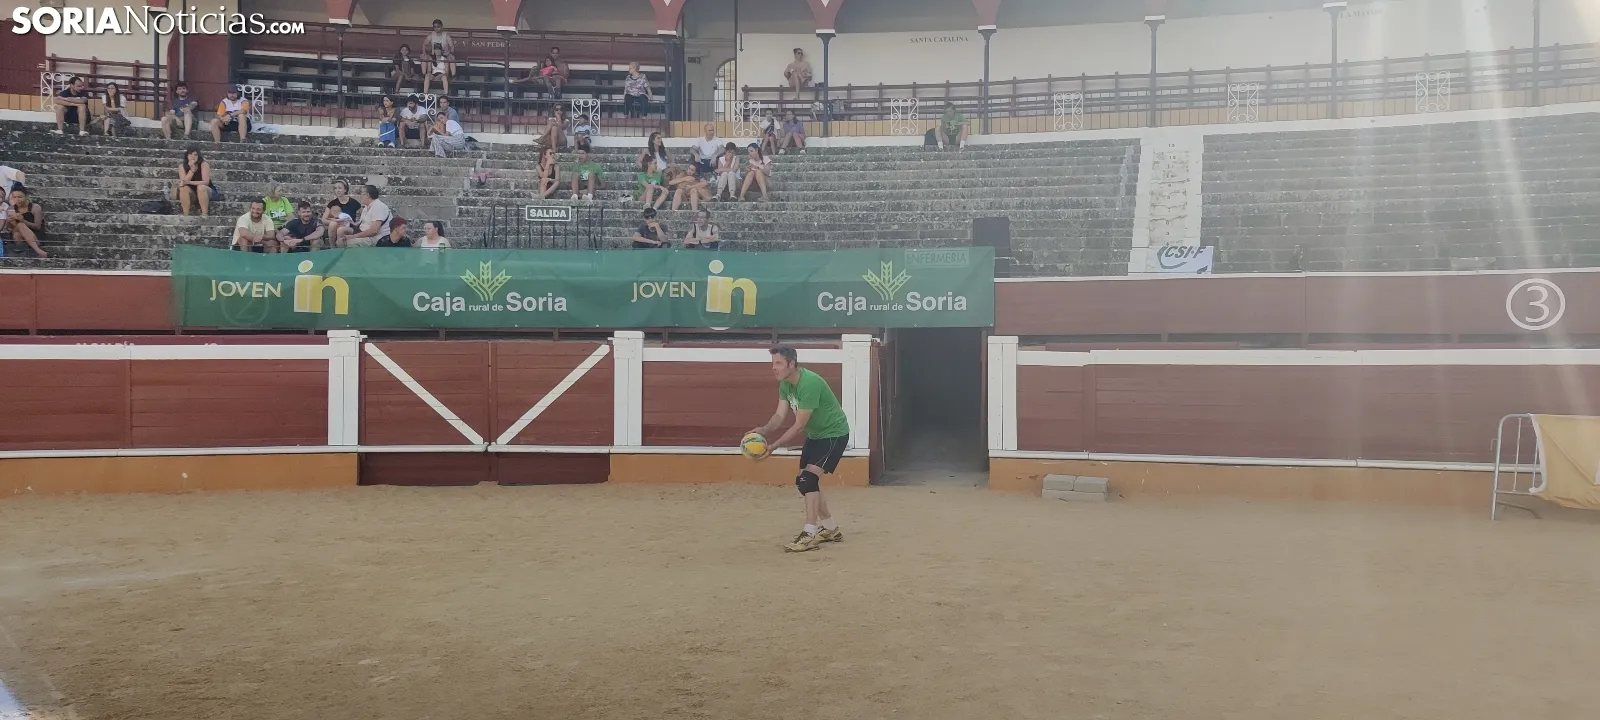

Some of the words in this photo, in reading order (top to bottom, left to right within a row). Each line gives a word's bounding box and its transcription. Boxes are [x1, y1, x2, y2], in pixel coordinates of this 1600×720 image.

[529, 208, 567, 218] SALIDA
[209, 279, 282, 301] JOVEN
[293, 259, 350, 315] in
[631, 281, 696, 303] JOVEN
[705, 259, 758, 316] in
[412, 291, 466, 317] Caja
[468, 303, 490, 312] rural
[491, 303, 504, 312] de
[506, 291, 568, 312] Soria
[817, 291, 868, 316] Caja
[869, 302, 890, 311] rural
[891, 302, 904, 311] de
[906, 291, 967, 312] Soria
[1525, 285, 1550, 323] 3
